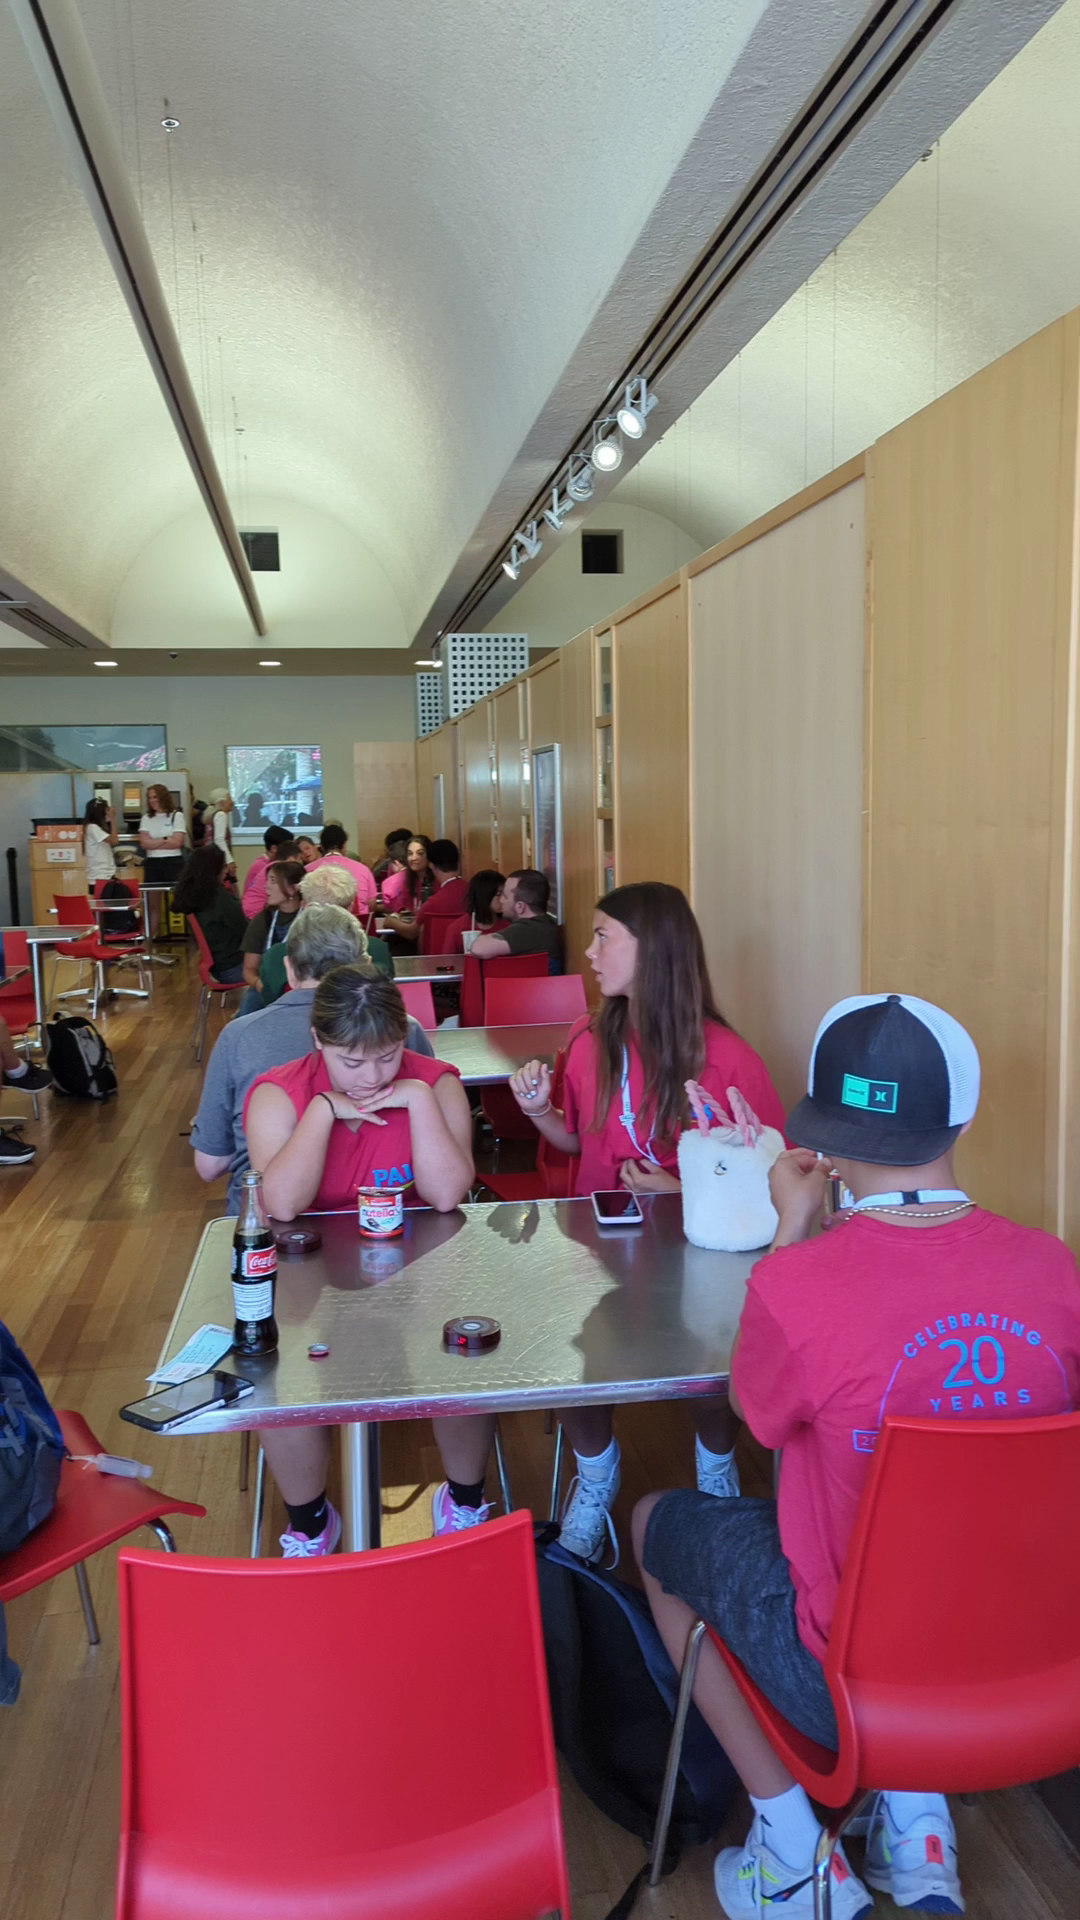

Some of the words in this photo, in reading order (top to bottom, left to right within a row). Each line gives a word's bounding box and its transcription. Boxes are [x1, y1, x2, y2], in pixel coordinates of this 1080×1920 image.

[903, 1312, 1042, 1359] CELEBRATING
[938, 1335, 1006, 1389] 20
[929, 1388, 1032, 1413] YEARS
